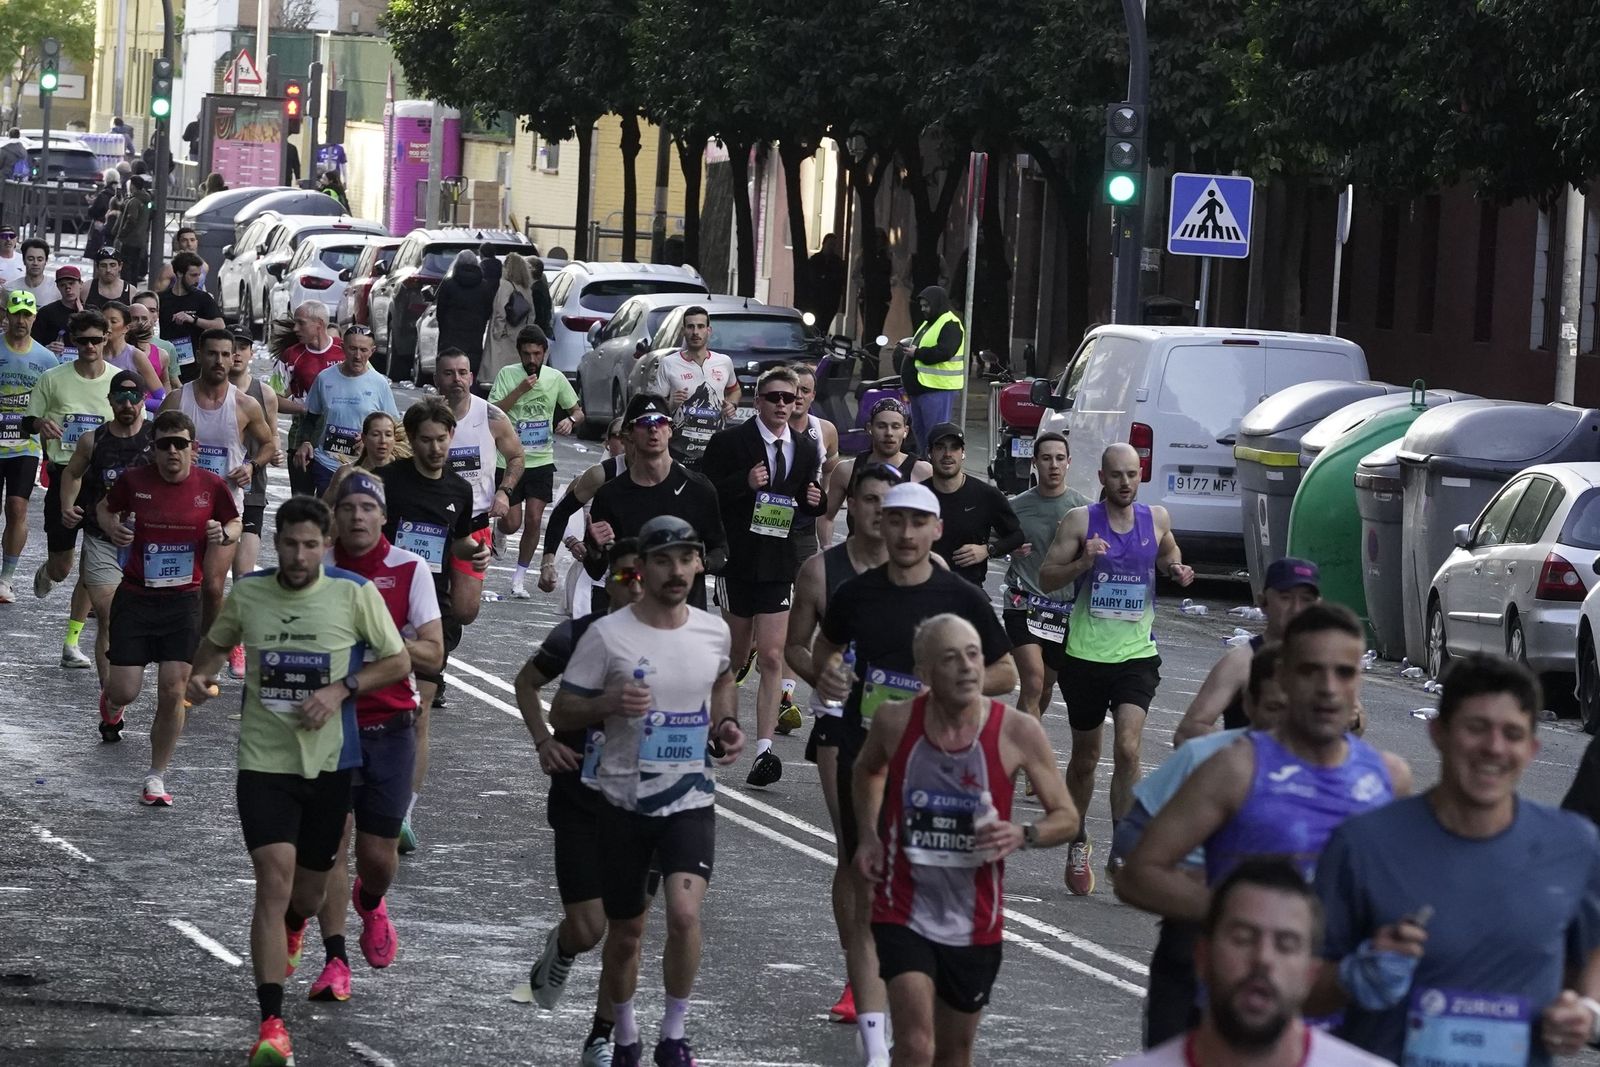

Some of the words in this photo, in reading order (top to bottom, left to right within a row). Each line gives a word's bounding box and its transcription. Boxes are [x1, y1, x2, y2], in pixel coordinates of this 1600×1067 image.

[330, 443, 352, 455] ALAIN
[1176, 477, 1209, 490] 9177
[1213, 479, 1237, 492] MFY
[753, 515, 791, 528] SZKUDLAR
[415, 524, 442, 535] ZURICH
[161, 544, 190, 552] ZURICH
[158, 566, 180, 577] JEFF
[1111, 574, 1142, 583] ZURICH
[1111, 588, 1128, 597] 7913
[1091, 596, 1122, 609] HAIRY
[1124, 599, 1144, 610] BUT
[283, 655, 323, 665] ZURICH
[888, 675, 924, 691] ZURIC
[260, 687, 293, 699] SUPER
[669, 715, 704, 725] ZURICH
[656, 746, 694, 759] LOUIS
[932, 795, 978, 808] ZURICH
[911, 830, 976, 850] PATRICE
